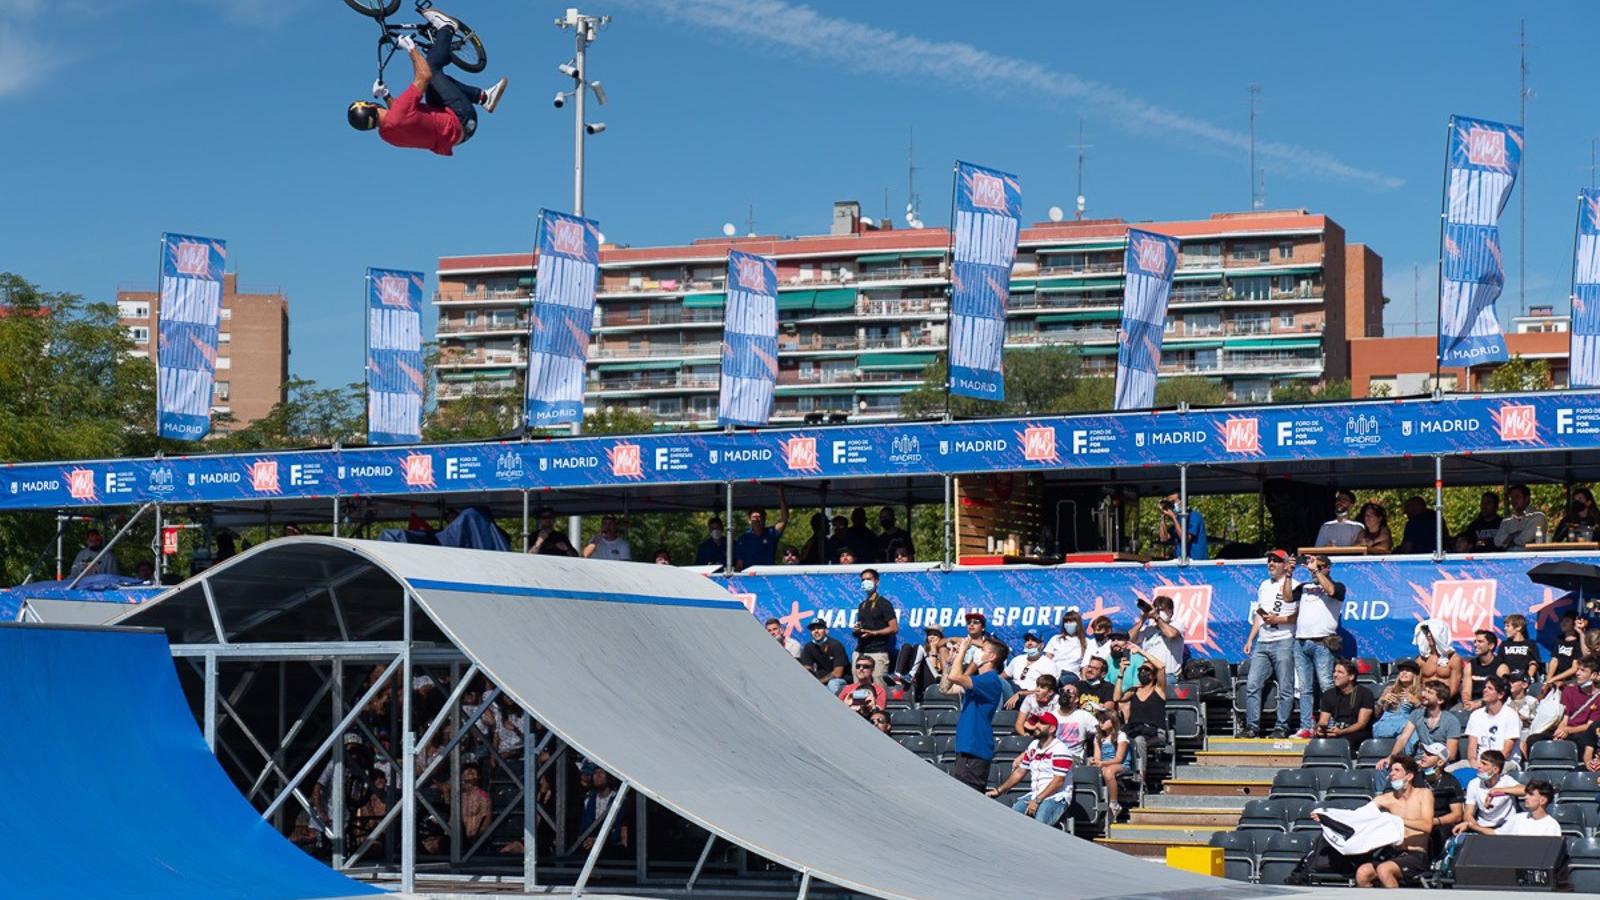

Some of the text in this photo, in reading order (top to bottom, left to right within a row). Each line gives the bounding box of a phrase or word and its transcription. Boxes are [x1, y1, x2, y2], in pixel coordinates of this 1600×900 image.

[1453, 344, 1500, 359] MADRID
[960, 379, 996, 393] MADRID
[536, 408, 576, 420] MADRID
[164, 422, 203, 434] MADRID
[1420, 419, 1480, 433] MADRID
[1152, 431, 1207, 444] MADRID
[956, 439, 1007, 453] MADRID
[724, 449, 772, 462] MADRID
[553, 456, 598, 469] MADRID
[201, 472, 241, 483] MADRID
[351, 466, 393, 477] MADRID
[23, 481, 59, 492] MADRID
[1437, 585, 1488, 633] MuS
